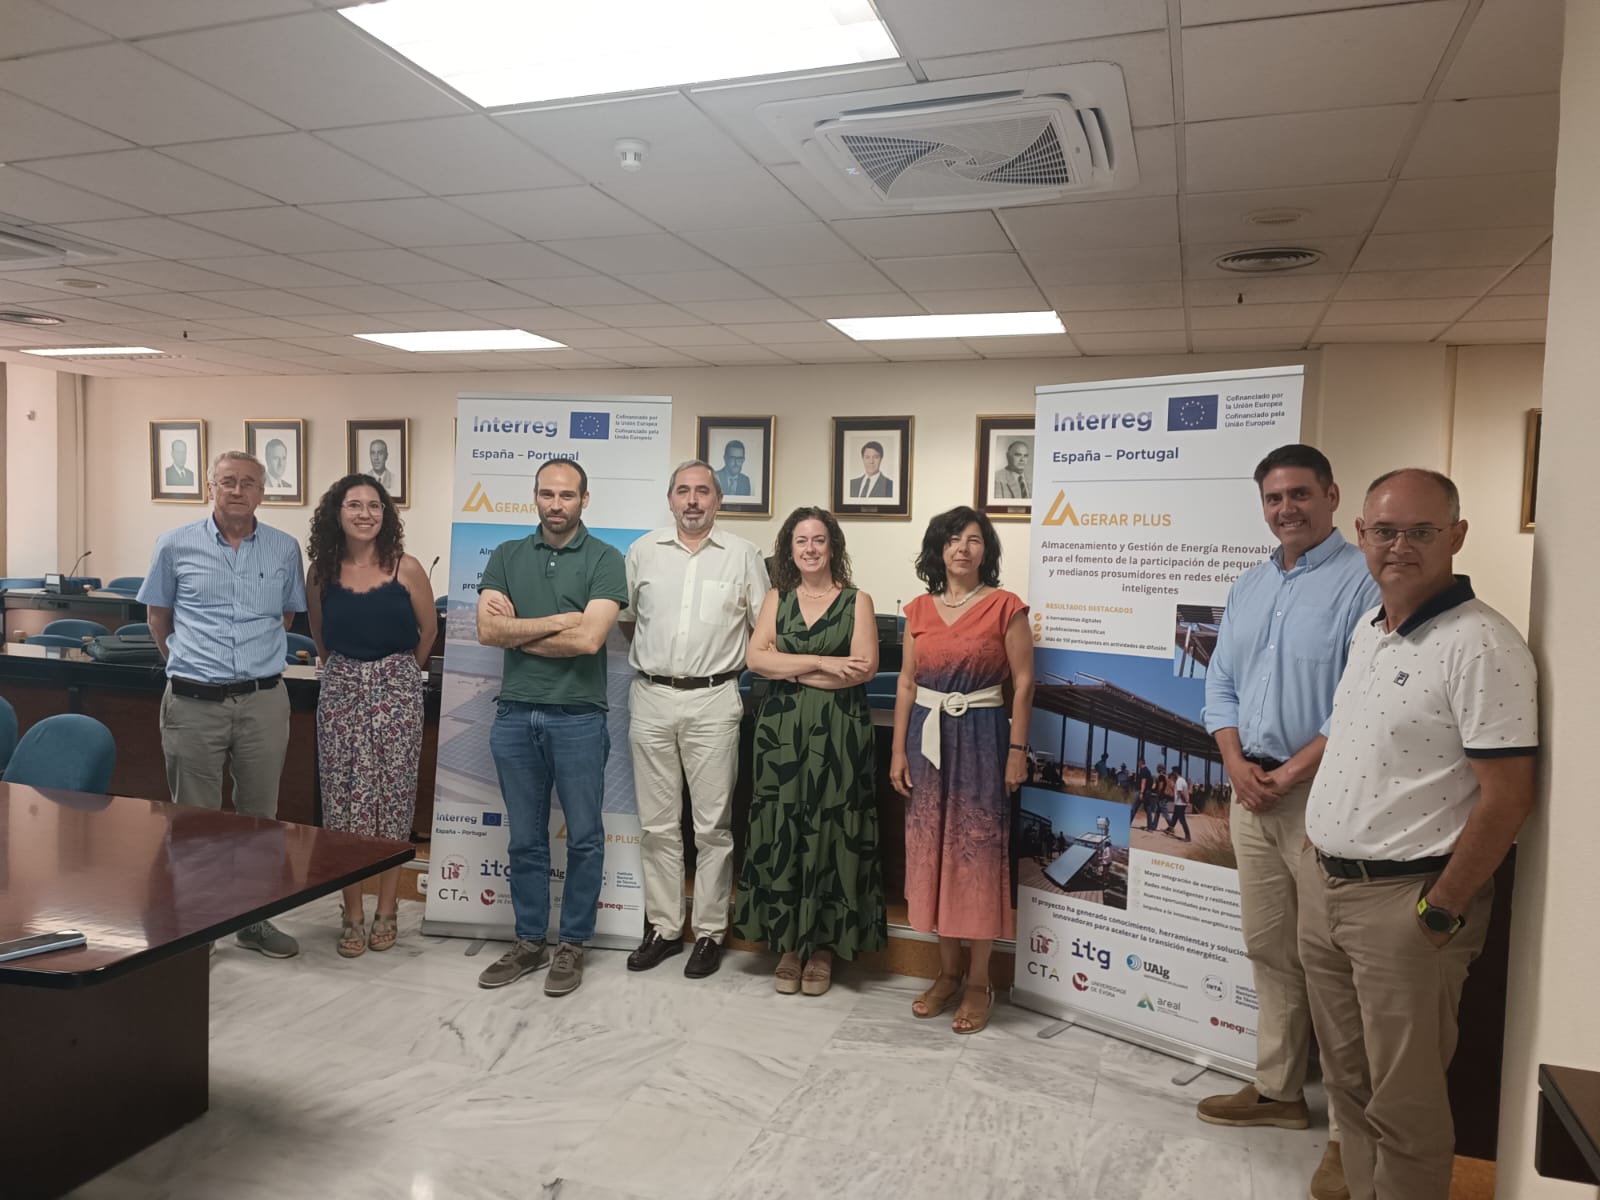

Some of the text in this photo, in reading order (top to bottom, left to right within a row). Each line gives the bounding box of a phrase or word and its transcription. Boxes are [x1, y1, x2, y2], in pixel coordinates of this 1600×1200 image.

[1226, 393, 1270, 401] Cofinanciado
[1054, 411, 1152, 432] Interreg
[1225, 411, 1269, 419] Cofinanciado
[474, 416, 558, 437] Interreg
[472, 449, 514, 460] España
[1053, 450, 1101, 464] España
[1116, 447, 1179, 462] Portugal
[495, 502, 537, 513] GERAR
[1080, 512, 1172, 527] GERAR PLUS
[1041, 541, 1117, 550] Almacenamiento
[1120, 544, 1125, 552] y
[1128, 542, 1163, 552] Gestión
[1166, 543, 1178, 552] de
[1181, 544, 1219, 555] Energía
[1042, 555, 1063, 564] para
[1065, 554, 1073, 563] el
[1075, 554, 1113, 564] fomento
[1115, 556, 1126, 564] de
[1129, 556, 1138, 565] la
[1140, 557, 1204, 568] participación
[1207, 558, 1220, 567] de
[1049, 569, 1054, 577] y
[1057, 568, 1099, 577] medianos
[1101, 570, 1166, 579] prosumidores
[1184, 573, 1211, 582] redes
[1122, 584, 1179, 595] inteligentes
[1046, 603, 1133, 614] RESULTADOS DESTACADOS
[436, 813, 477, 824] Interreg
[615, 835, 640, 844] PLUS
[1152, 858, 1185, 871] IMPACTO
[550, 869, 565, 879] Alg
[1038, 899, 1065, 911] proyecto
[1067, 905, 1075, 913] ha
[1076, 909, 1108, 921] generado
[1159, 928, 1209, 948] herramientas
[1052, 912, 1093, 927] innovadoras
[1094, 923, 1110, 932] para
[1111, 926, 1139, 939] acelerar
[1149, 936, 1185, 951] transición
[1186, 947, 1229, 963] energética.
[1071, 938, 1111, 970] itg
[1144, 961, 1170, 980] UAlg
[1157, 998, 1181, 1011] areal
